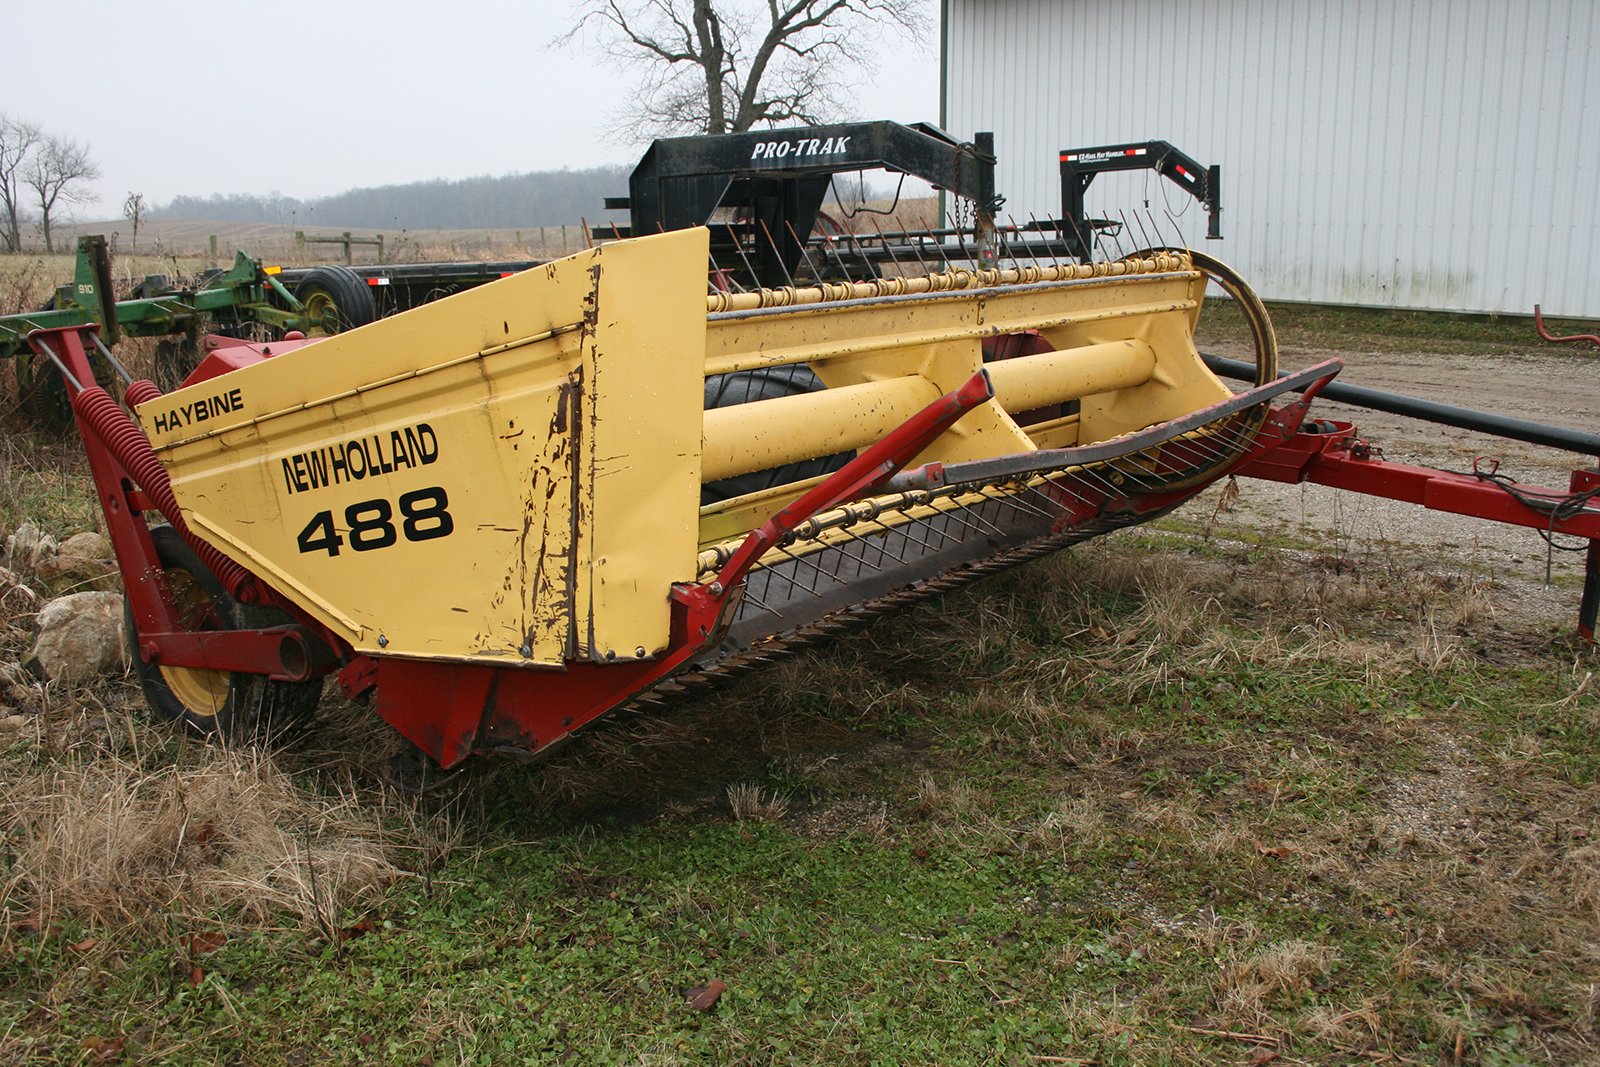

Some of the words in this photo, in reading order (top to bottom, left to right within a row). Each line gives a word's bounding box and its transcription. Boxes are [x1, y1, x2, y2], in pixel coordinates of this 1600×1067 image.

[751, 136, 851, 160] PRO-TRAK
[78, 284, 94, 295] 910
[153, 388, 244, 435] HAYBINE
[296, 486, 454, 557] 488
